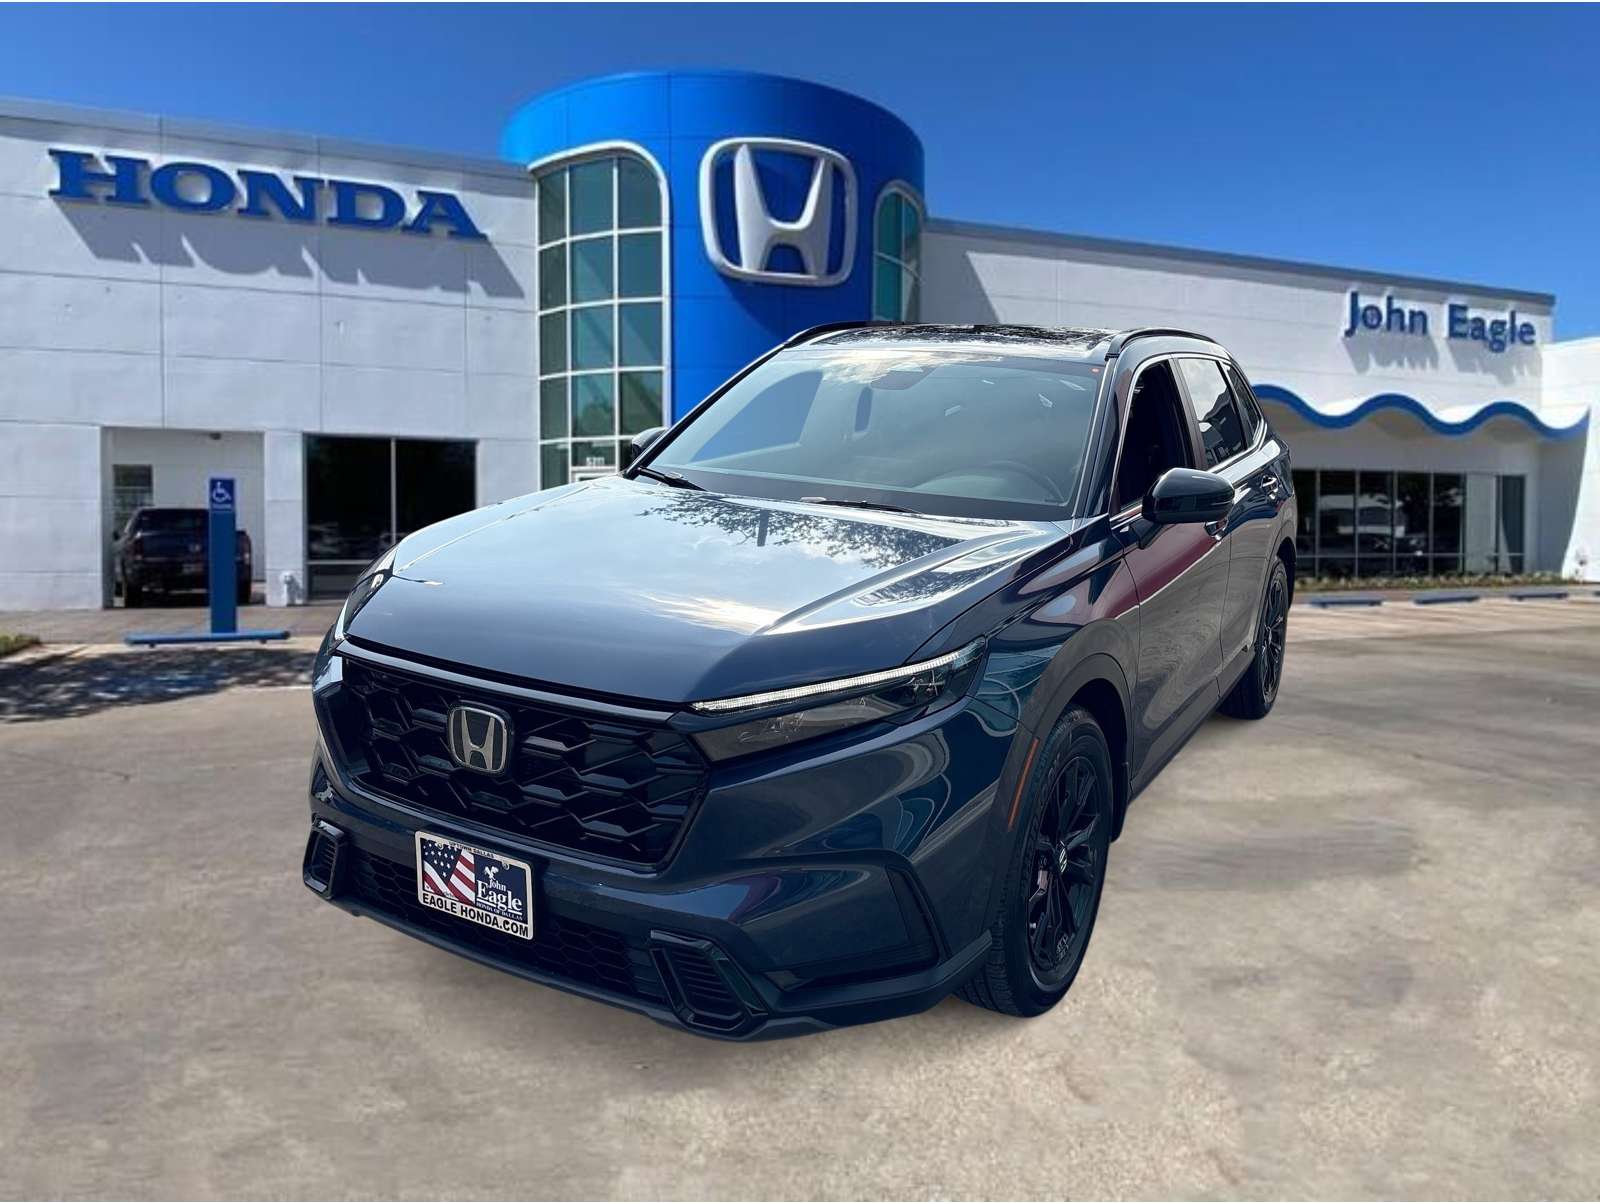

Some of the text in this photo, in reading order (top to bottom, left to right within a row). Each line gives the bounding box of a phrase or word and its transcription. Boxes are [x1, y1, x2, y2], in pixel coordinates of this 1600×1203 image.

[48, 148, 488, 240] HONDA
[1344, 290, 1536, 353] John Eagle
[476, 879, 523, 912] Eagle
[489, 879, 507, 892] John
[422, 892, 529, 938] EAGLE HONDA.COM
